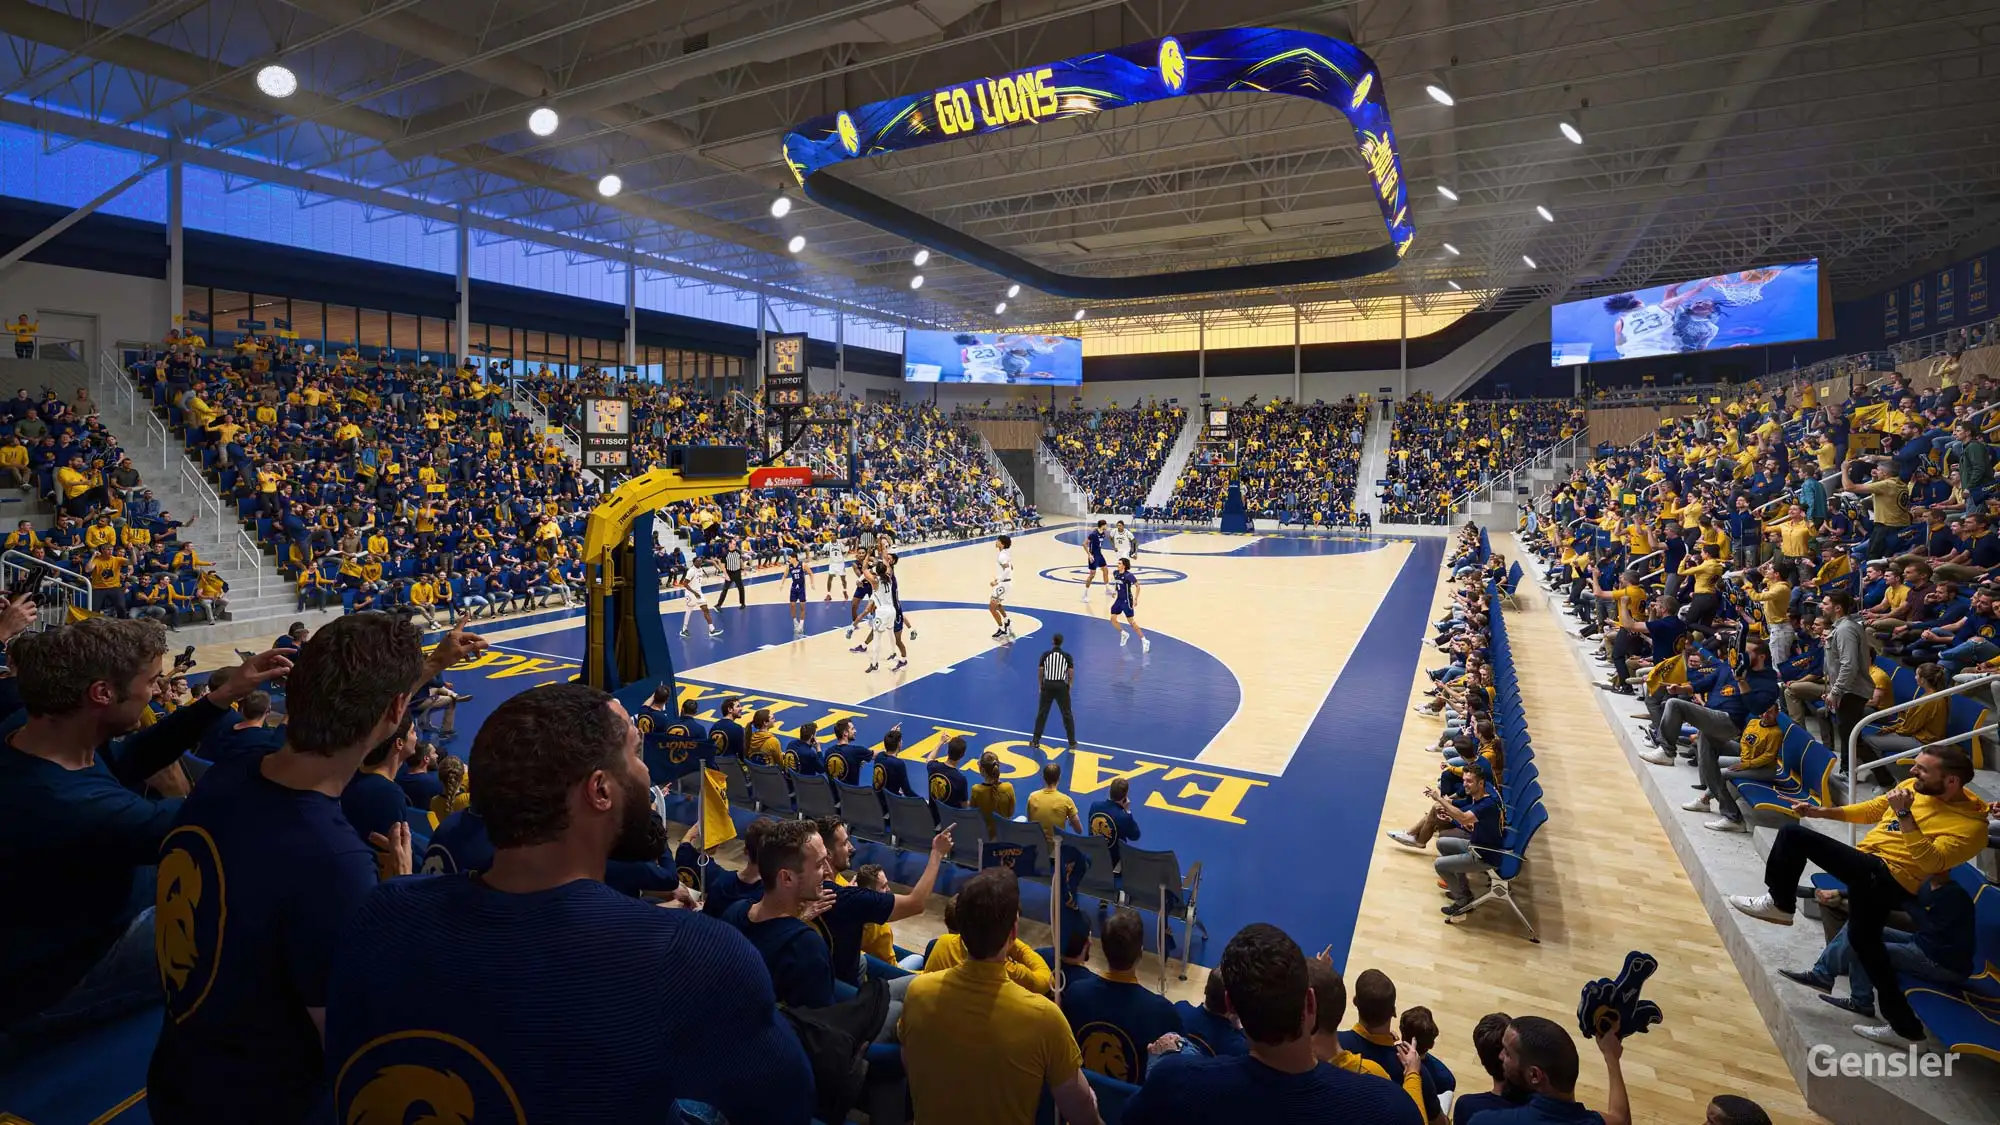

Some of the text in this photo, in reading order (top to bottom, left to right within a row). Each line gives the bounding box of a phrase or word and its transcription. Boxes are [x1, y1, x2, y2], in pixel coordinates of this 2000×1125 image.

[934, 68, 1058, 134] GO LIONS
[1630, 313, 1663, 334] 23
[973, 349, 995, 359] 23
[657, 740, 698, 750] LIONS
[867, 725, 1269, 825] EAST
